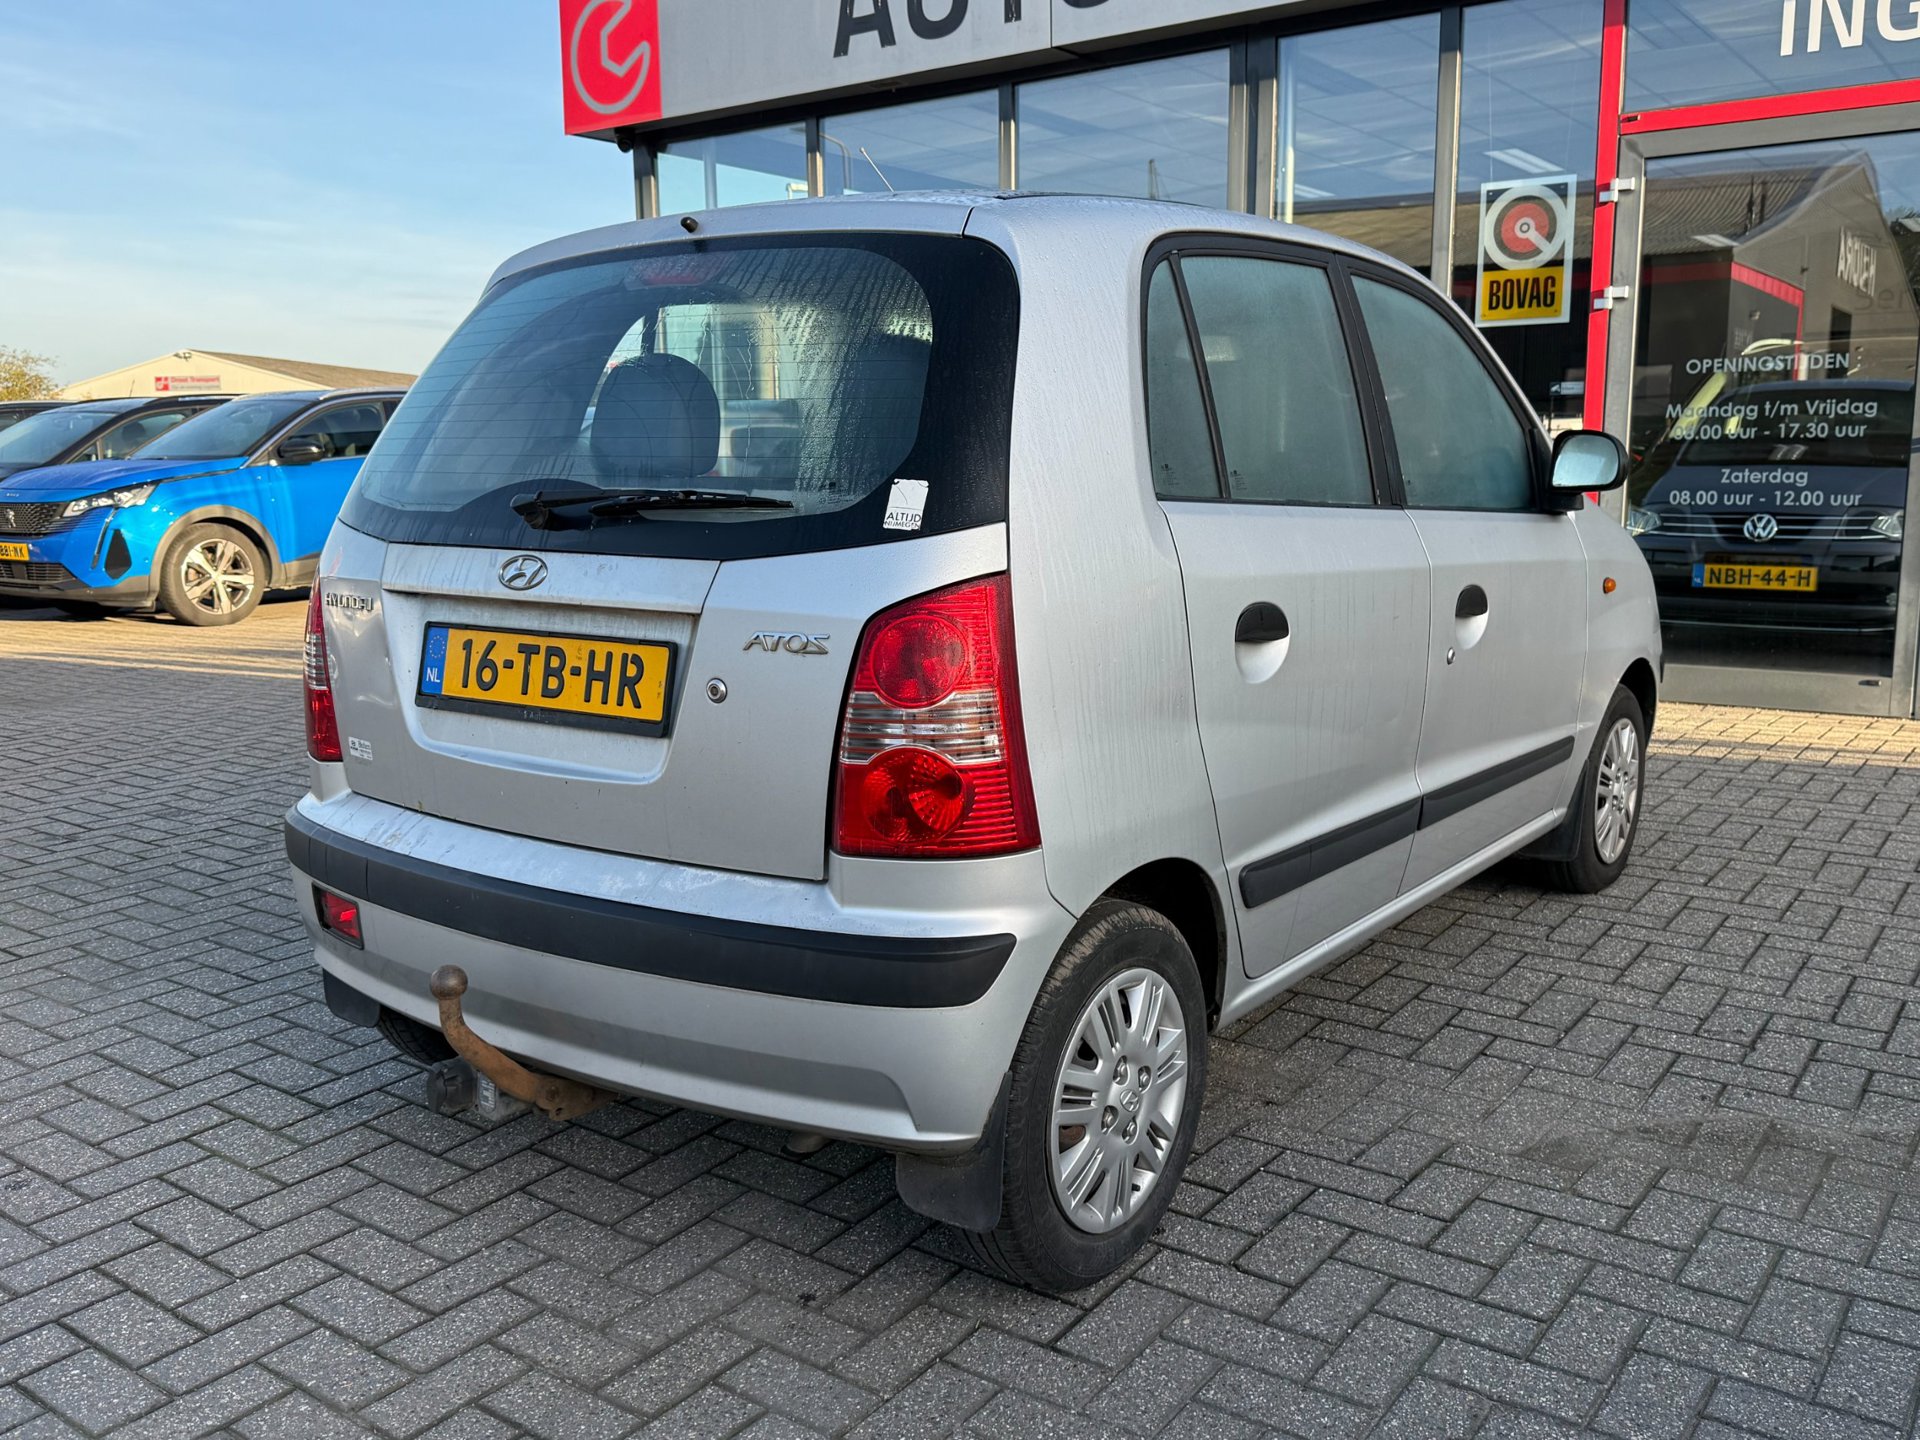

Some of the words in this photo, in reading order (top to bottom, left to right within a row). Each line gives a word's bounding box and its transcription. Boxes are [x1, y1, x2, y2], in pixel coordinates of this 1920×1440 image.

[833, 0, 1108, 58] AU
[1488, 275, 1557, 311] BOVAG
[1665, 402, 1758, 420] Maandag
[1764, 400, 1799, 418] t/m
[1805, 399, 1878, 418] Vrijdag
[1673, 424, 1722, 441] 08.00
[1778, 422, 1829, 439] 17.30
[1835, 424, 1868, 437] uur
[1720, 468, 1809, 487] Zaterdag
[1669, 490, 1718, 506] 08.00
[1723, 493, 1754, 506] uur
[1774, 490, 1824, 507] 12.00
[1830, 492, 1863, 507] uur
[886, 511, 922, 523] ALTIJD
[1708, 567, 1812, 588] NBH-44-H
[324, 592, 374, 611] HYUNDAI
[426, 666, 441, 683] NL
[461, 638, 645, 710] 16-TB-HR
